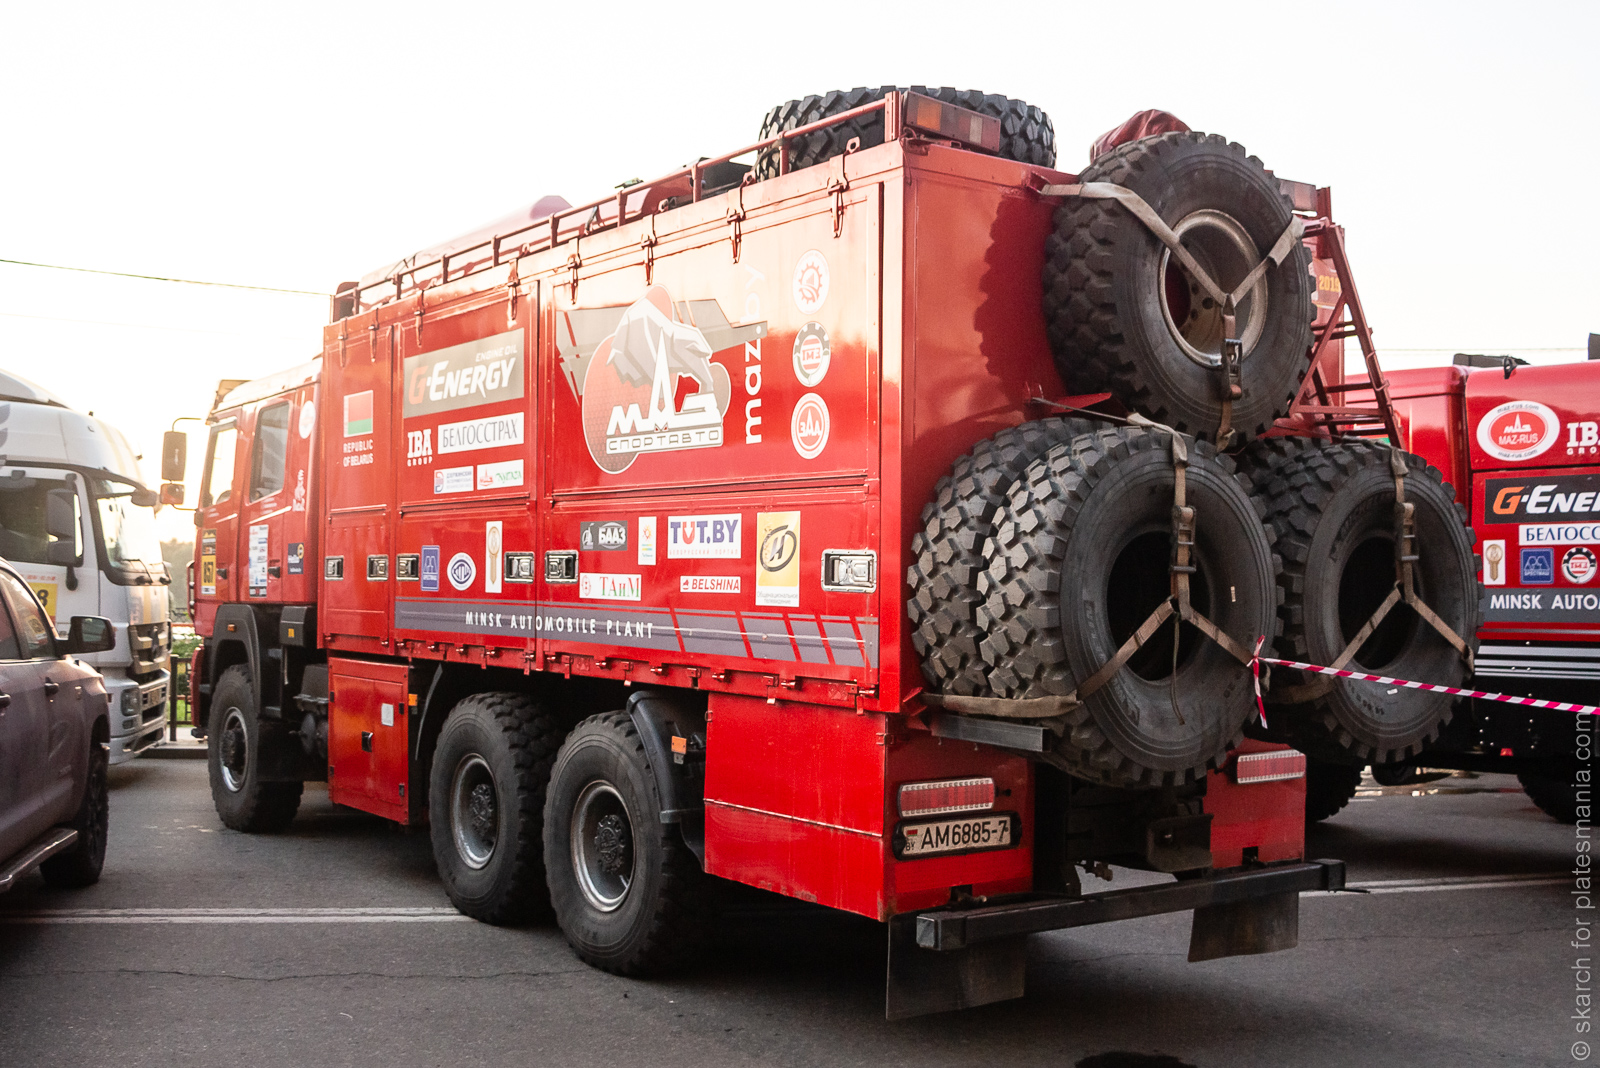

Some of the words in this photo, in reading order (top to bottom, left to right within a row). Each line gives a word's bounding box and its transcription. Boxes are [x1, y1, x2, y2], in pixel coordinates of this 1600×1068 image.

[476, 348, 504, 363] ENGINE
[504, 344, 518, 356] OIL
[442, 418, 519, 448] БЕЛГОССТРАХ
[608, 429, 720, 452] СПОРТАВТО
[1498, 433, 1539, 446] MAZ-RUS
[1566, 421, 1600, 448] IB
[343, 439, 374, 454] REPUBLIC
[407, 428, 433, 459] IBA
[343, 456, 351, 467] OF
[350, 453, 374, 466] BELARUS
[407, 456, 433, 467] GROUP
[598, 527, 627, 545] БААЗ
[670, 519, 739, 545] TUT.BY
[691, 578, 740, 591] BELSHINA
[1490, 594, 1542, 610] MINSK
[1551, 594, 1600, 610] AUTO
[465, 611, 502, 628] MINSK
[510, 615, 596, 635] AUTOMOBILE
[606, 619, 654, 639] PLANT
[921, 819, 1009, 850] AM6885-7
